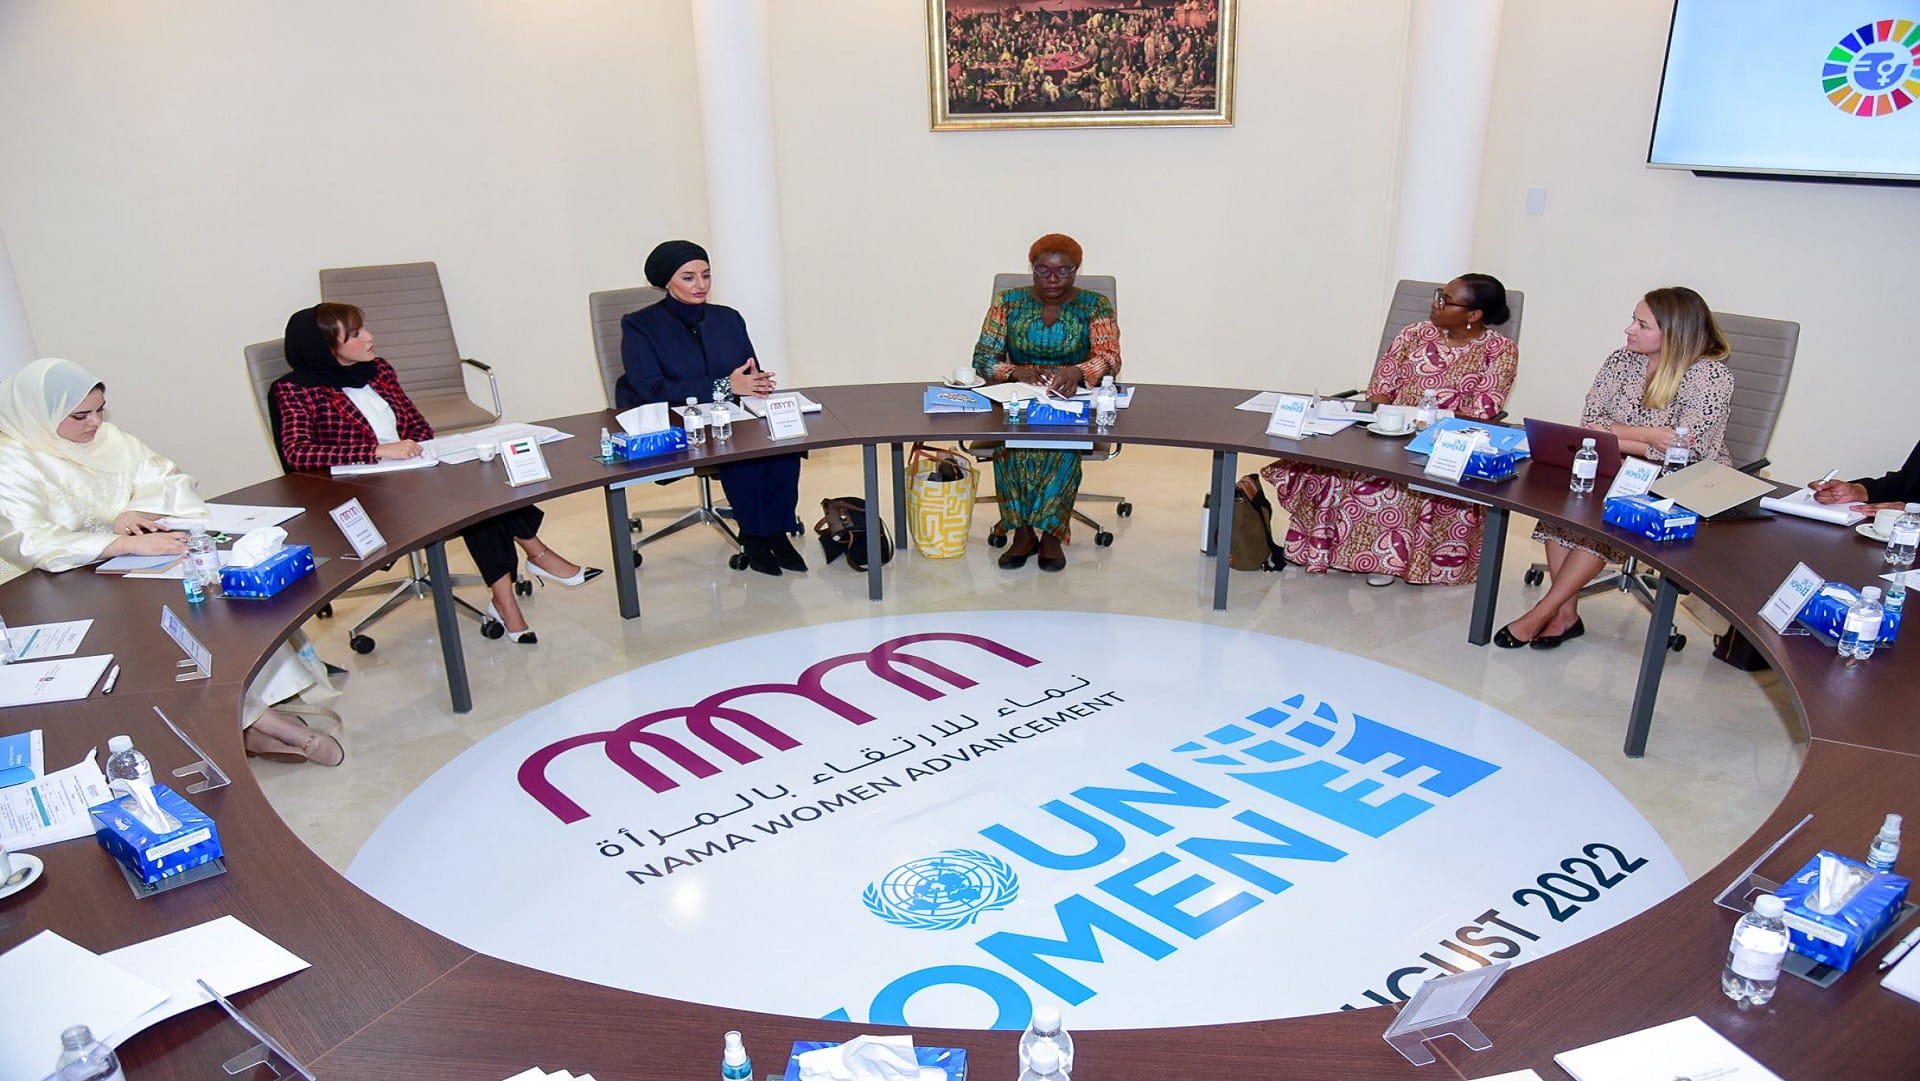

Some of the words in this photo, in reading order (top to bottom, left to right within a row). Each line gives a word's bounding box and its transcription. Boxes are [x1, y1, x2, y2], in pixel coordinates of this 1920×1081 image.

[812, 714, 979, 785] للارتقاء
[997, 674, 1090, 718] نماء
[596, 784, 798, 858] بالمرأة
[625, 834, 756, 885] NAMA
[752, 776, 902, 835] WOMEN
[905, 691, 1126, 782] ADVANCEMENT
[978, 761, 1230, 872] UN
[820, 809, 1349, 1030] OMEN
[1340, 908, 1541, 1009] GUST
[1512, 843, 1649, 923] 2022
